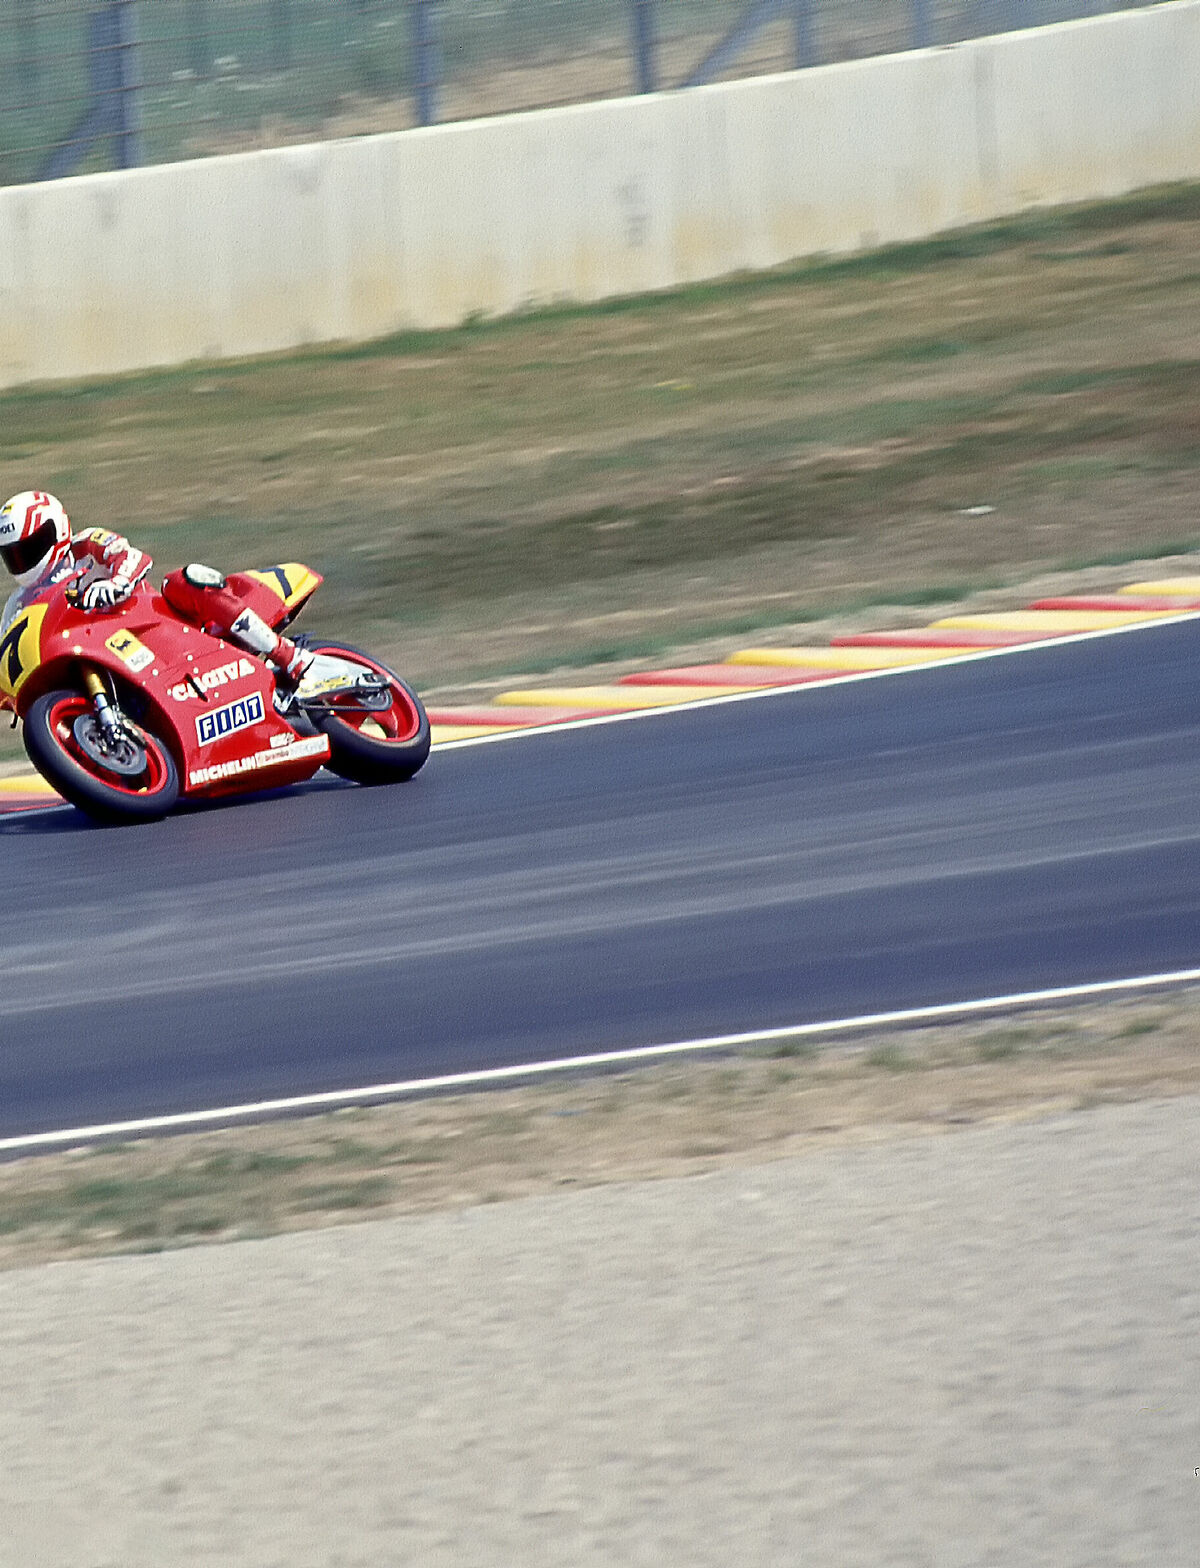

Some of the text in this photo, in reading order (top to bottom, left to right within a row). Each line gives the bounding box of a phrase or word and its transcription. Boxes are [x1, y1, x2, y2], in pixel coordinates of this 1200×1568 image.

[0, 616, 29, 687] 7
[199, 697, 262, 741] FIAT
[189, 756, 257, 785] MICHELIN
